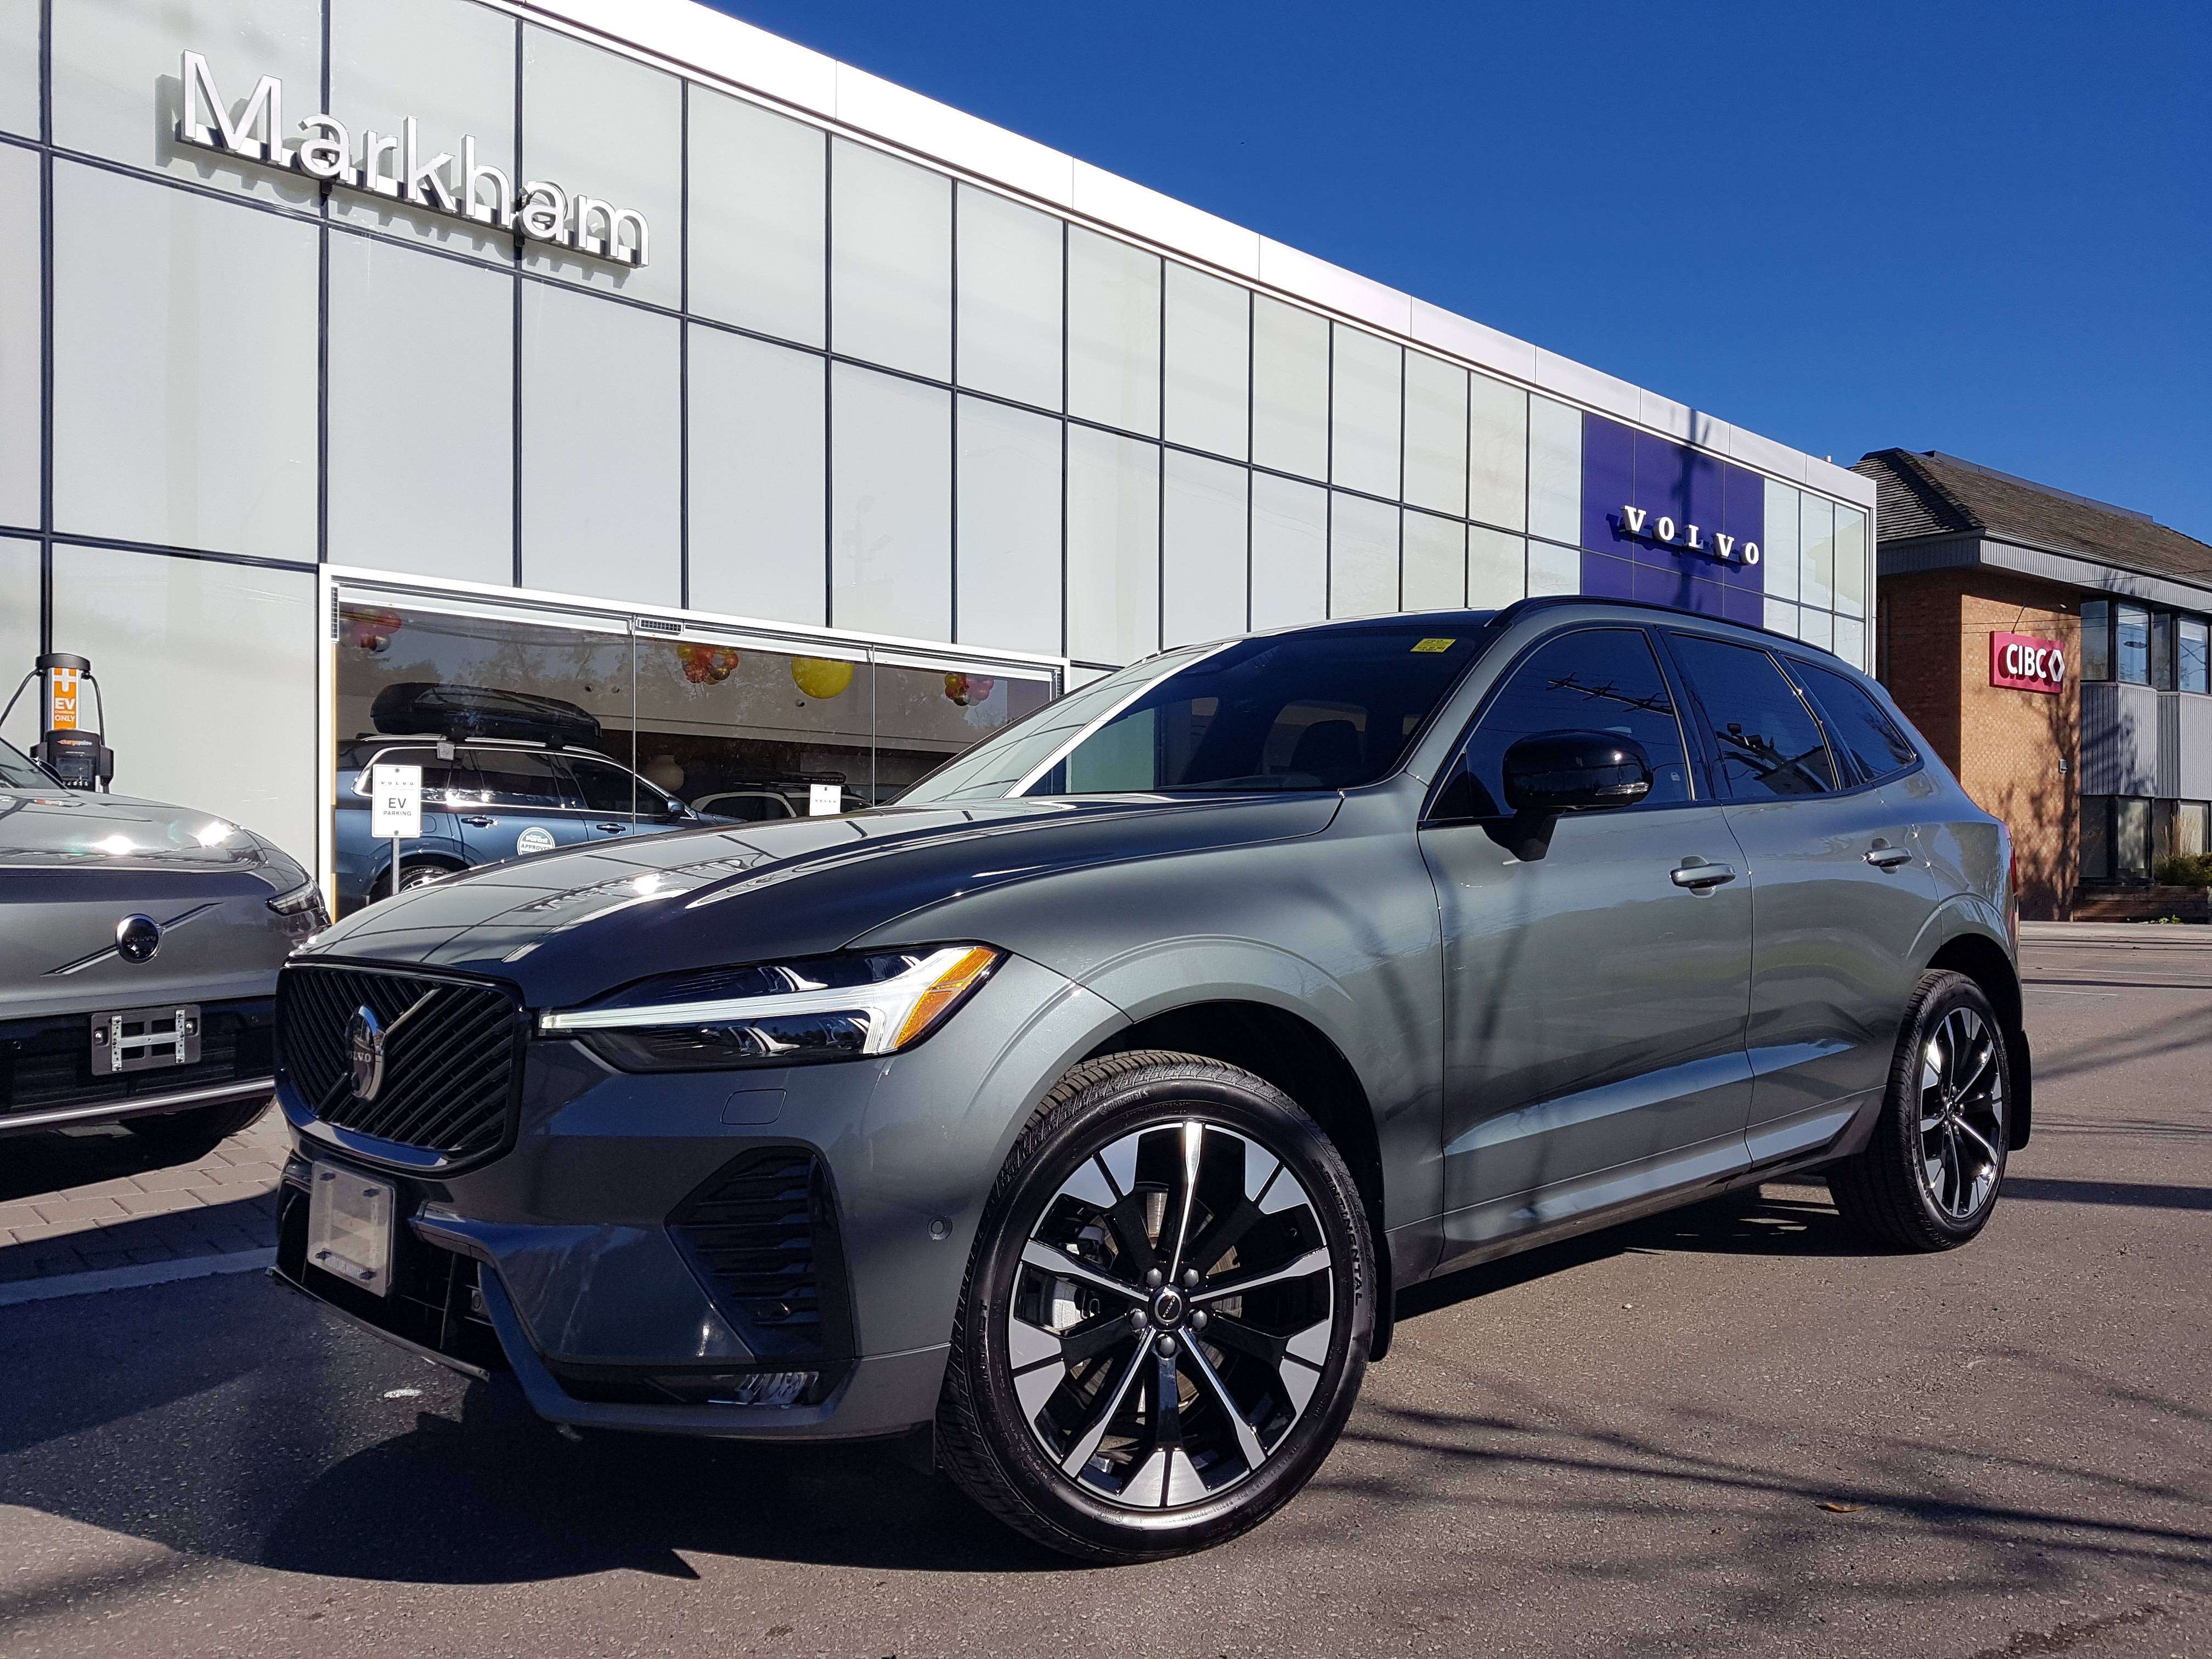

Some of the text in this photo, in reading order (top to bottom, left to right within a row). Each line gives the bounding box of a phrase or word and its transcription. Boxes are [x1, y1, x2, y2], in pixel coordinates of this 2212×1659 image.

[182, 49, 650, 267] Markham
[1622, 505, 1759, 565] VOLVO
[2006, 644, 2047, 679] CIBC
[54, 697, 75, 710] EV
[388, 798, 407, 809] EV
[526, 835, 548, 843] Parent
